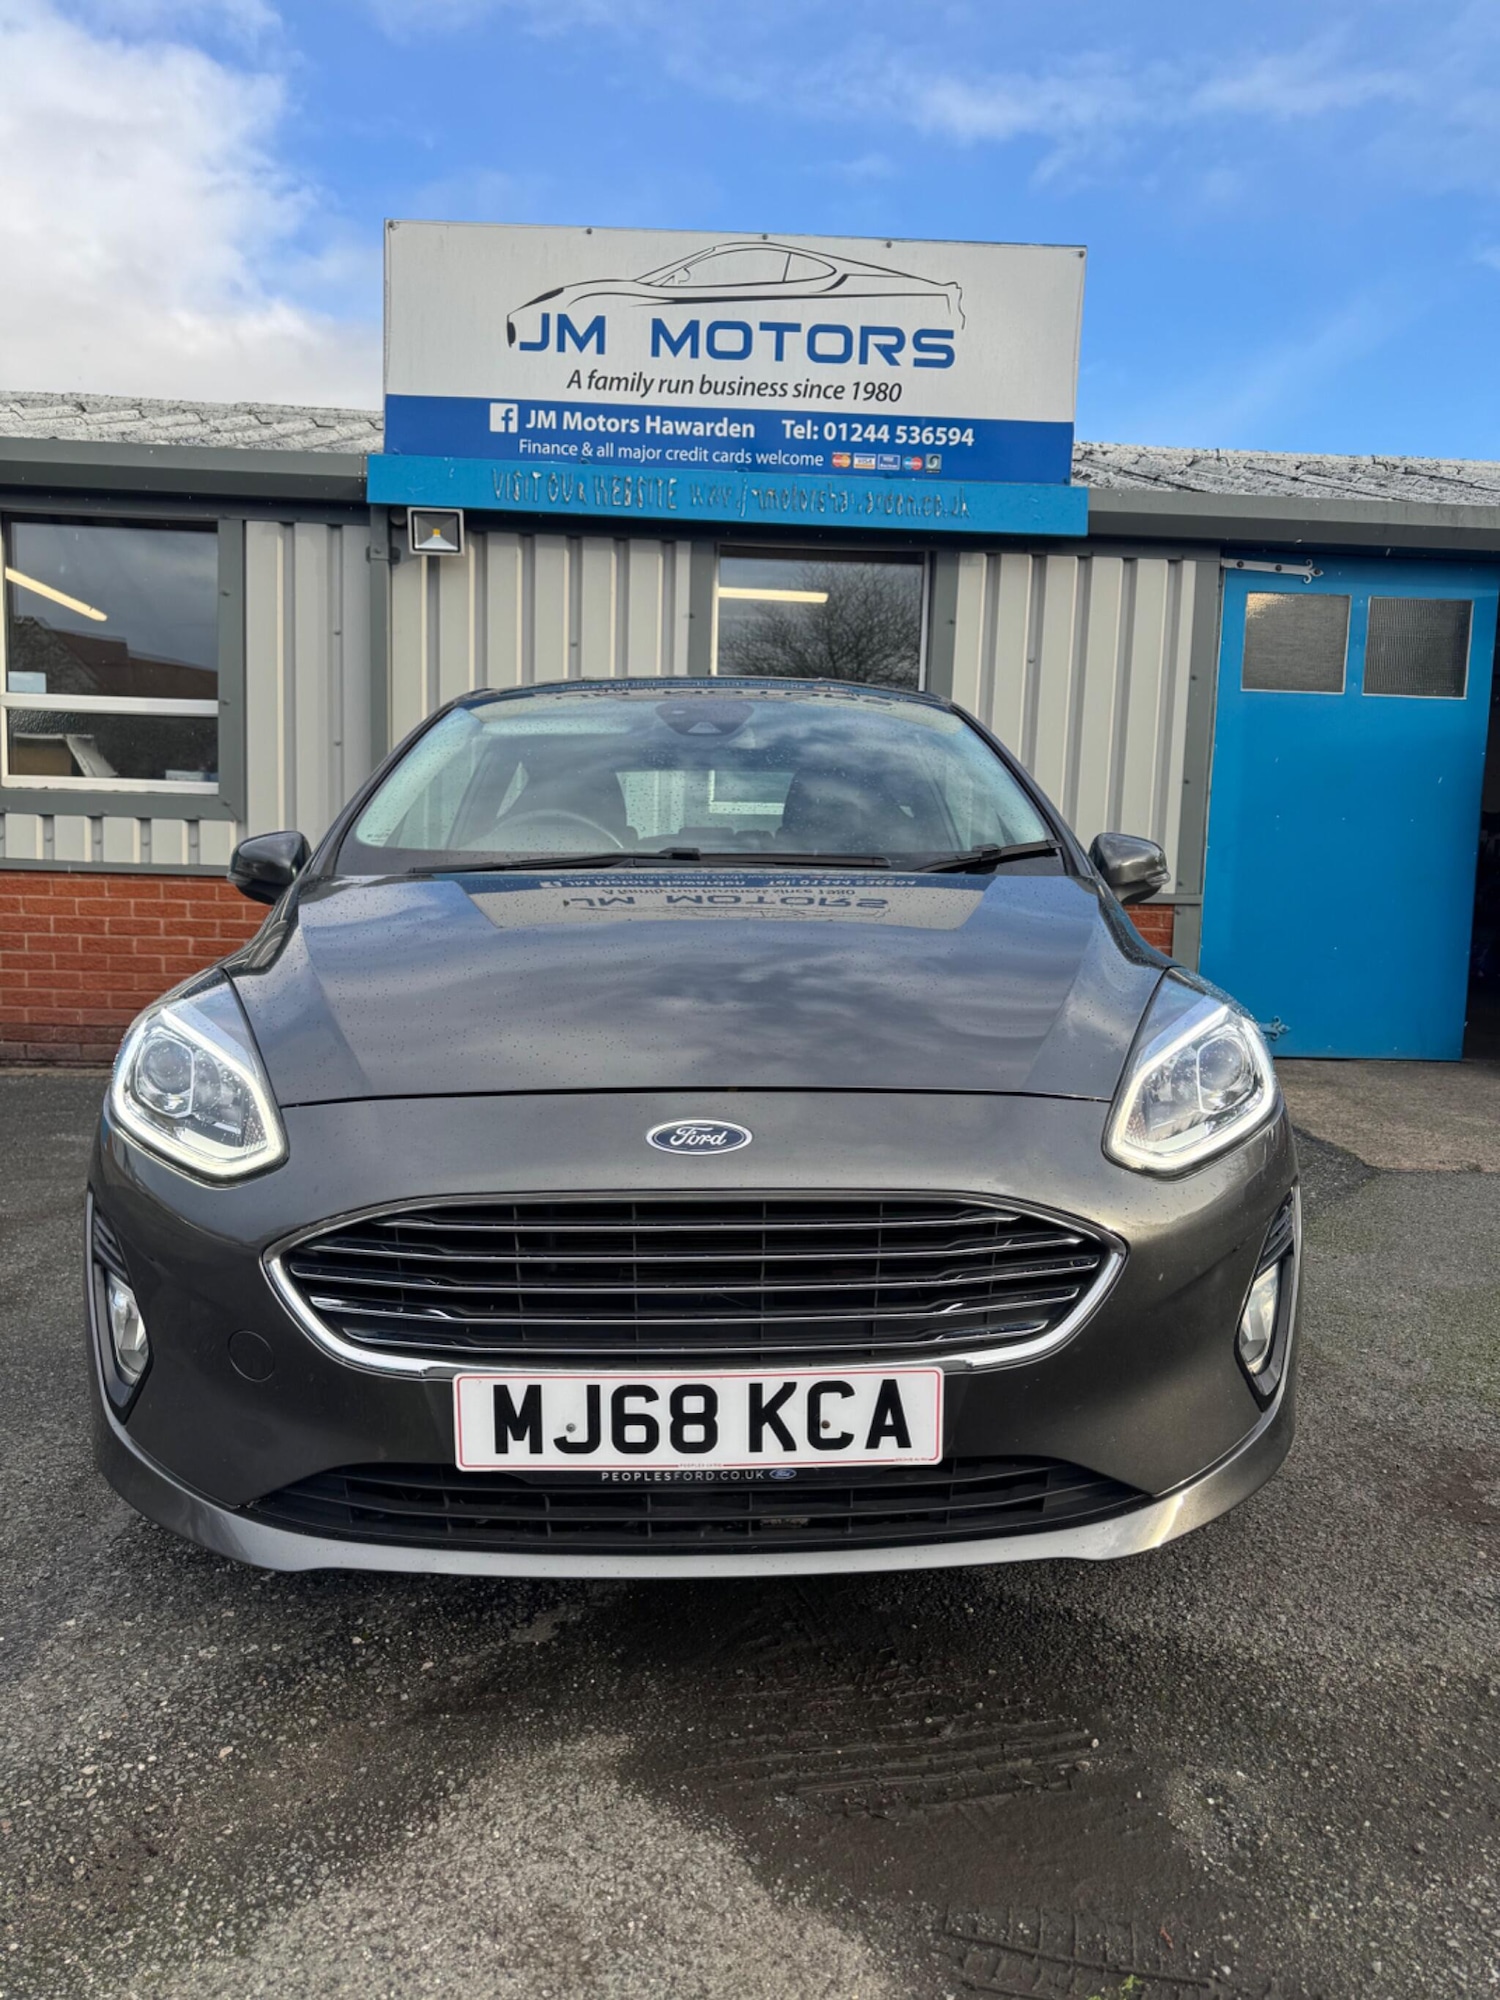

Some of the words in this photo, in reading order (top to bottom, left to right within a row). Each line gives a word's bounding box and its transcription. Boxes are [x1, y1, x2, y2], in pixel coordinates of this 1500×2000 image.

[519, 312, 606, 355] JM
[651, 318, 956, 369] MOTORS
[566, 369, 582, 389] A
[587, 368, 654, 398] family
[658, 377, 694, 395] run
[699, 374, 788, 398] business
[792, 378, 845, 400] since
[852, 381, 902, 402] 1980
[525, 409, 557, 430] JM
[562, 411, 640, 434] Motors
[645, 415, 755, 438] Hawarden
[782, 419, 818, 440] Tel:
[823, 422, 890, 443] 01244
[895, 425, 974, 447] 536594
[519, 438, 578, 456] Finance
[581, 441, 593, 457] &
[596, 442, 614, 458] all
[618, 444, 662, 463] major
[665, 446, 708, 462] credit
[712, 447, 752, 464] cards
[756, 449, 824, 467] welcome
[492, 468, 542, 502] VISIT
[594, 474, 677, 510] WEBSITE
[670, 1126, 728, 1146] Ford
[492, 1383, 719, 1454] MJ68
[748, 1379, 913, 1453] KCA
[601, 1470, 765, 1482] PEOPLESFORD.CO.UK
